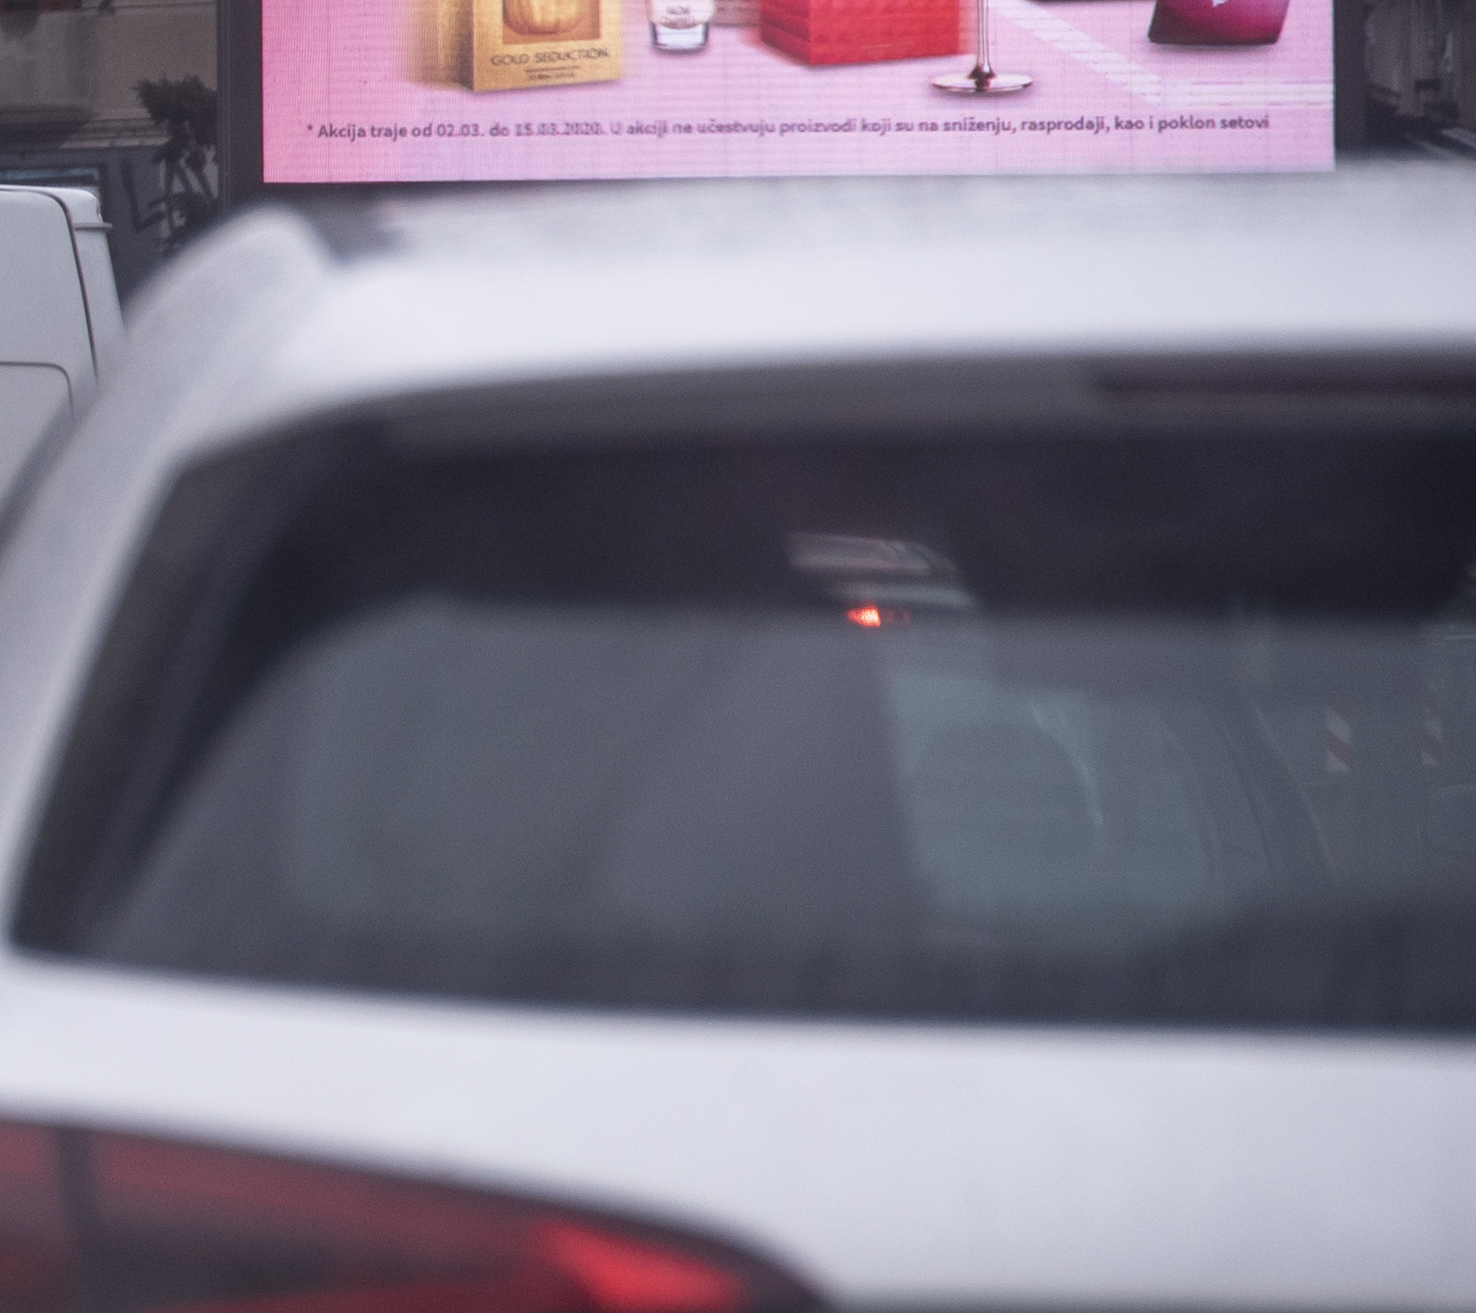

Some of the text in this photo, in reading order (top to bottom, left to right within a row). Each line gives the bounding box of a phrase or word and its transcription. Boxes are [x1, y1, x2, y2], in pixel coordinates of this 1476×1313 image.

[317, 123, 366, 143] Akcija
[369, 124, 408, 143] traje
[411, 123, 433, 137] od
[436, 124, 484, 138] 02.03.
[672, 123, 693, 134] ne
[697, 118, 775, 138] učestvuju
[779, 118, 857, 137] proizvodi
[861, 118, 892, 137] koji
[896, 120, 915, 132] su
[918, 120, 939, 132] na
[943, 116, 1017, 136] sniženju,
[1021, 116, 1109, 135] rasprodaji,
[1113, 116, 1145, 130] kao
[1157, 115, 1216, 134] poklon
[1219, 115, 1270, 129] setovi
